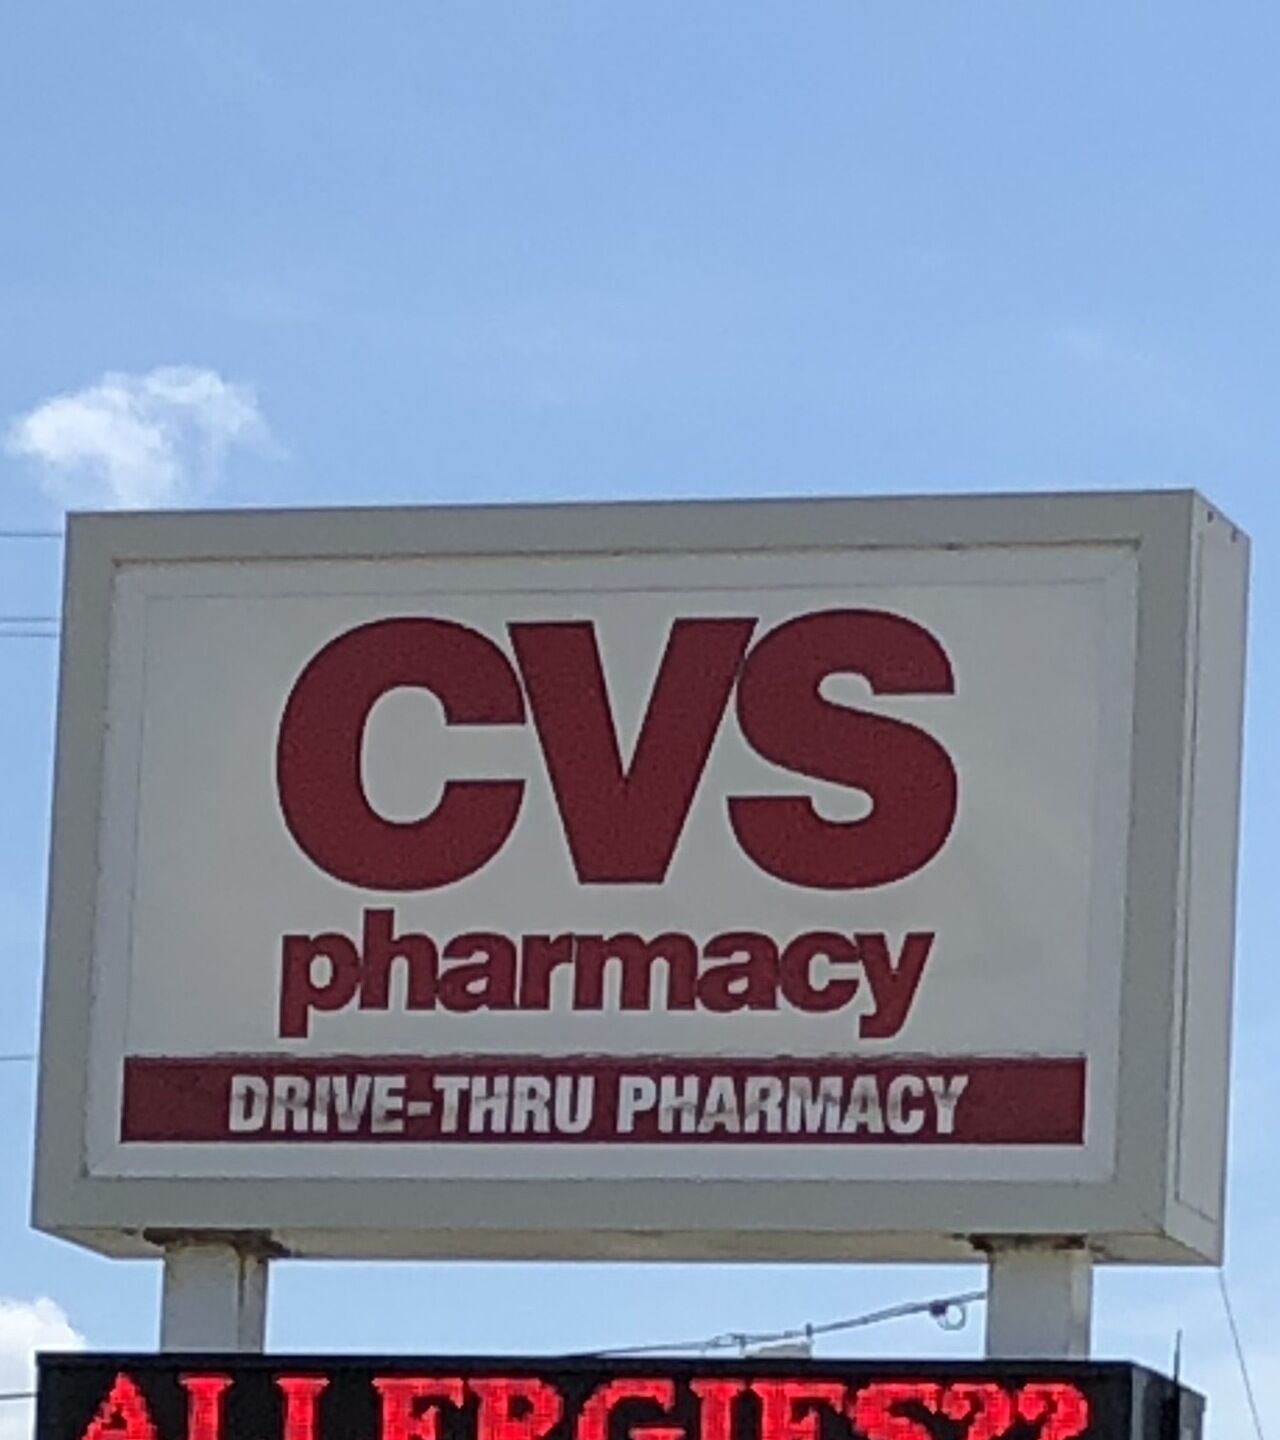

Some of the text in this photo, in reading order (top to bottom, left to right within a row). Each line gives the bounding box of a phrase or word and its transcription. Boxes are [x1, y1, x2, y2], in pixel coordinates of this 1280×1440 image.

[276, 609, 959, 891] CVS
[279, 909, 934, 1039] pharmacy
[228, 1074, 969, 1135] DRIVE-THRU PHARMACY
